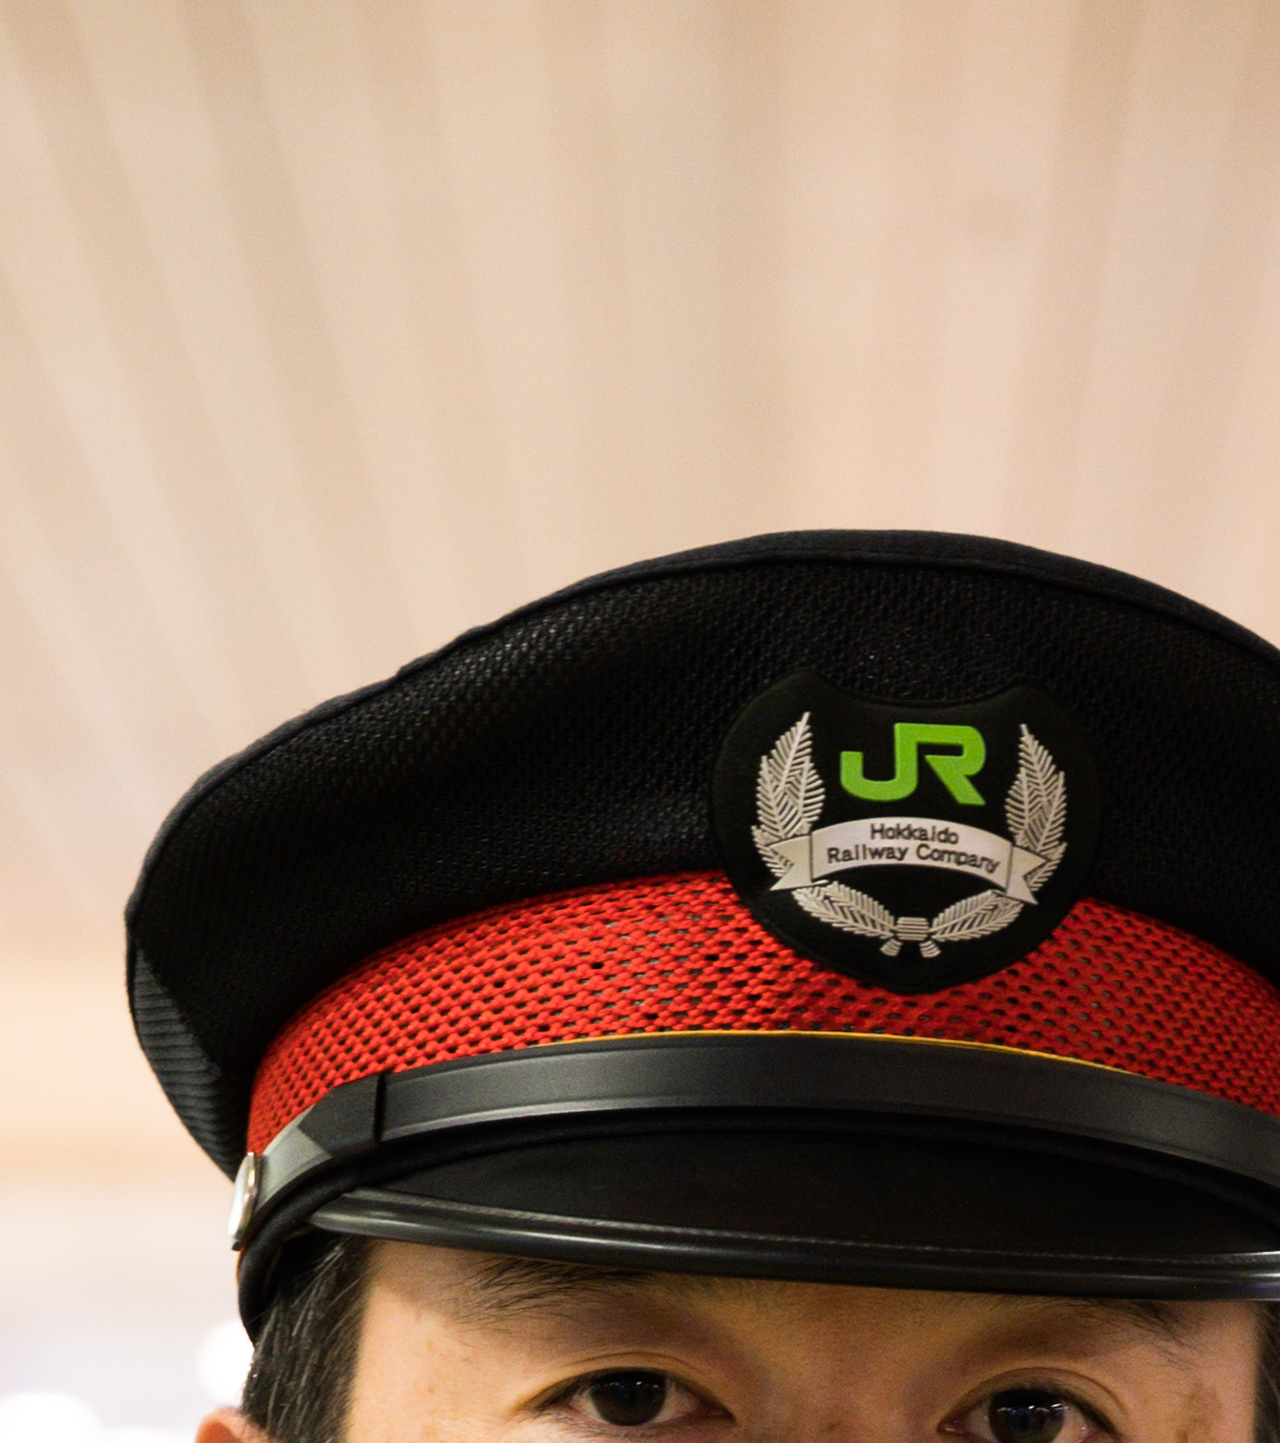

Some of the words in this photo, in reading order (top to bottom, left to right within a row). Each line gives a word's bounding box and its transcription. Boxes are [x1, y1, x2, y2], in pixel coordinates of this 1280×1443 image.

[840, 722, 986, 806] JR
[869, 822, 959, 846] Hokkaido
[827, 843, 908, 865] Railway
[916, 844, 1000, 875] Company
